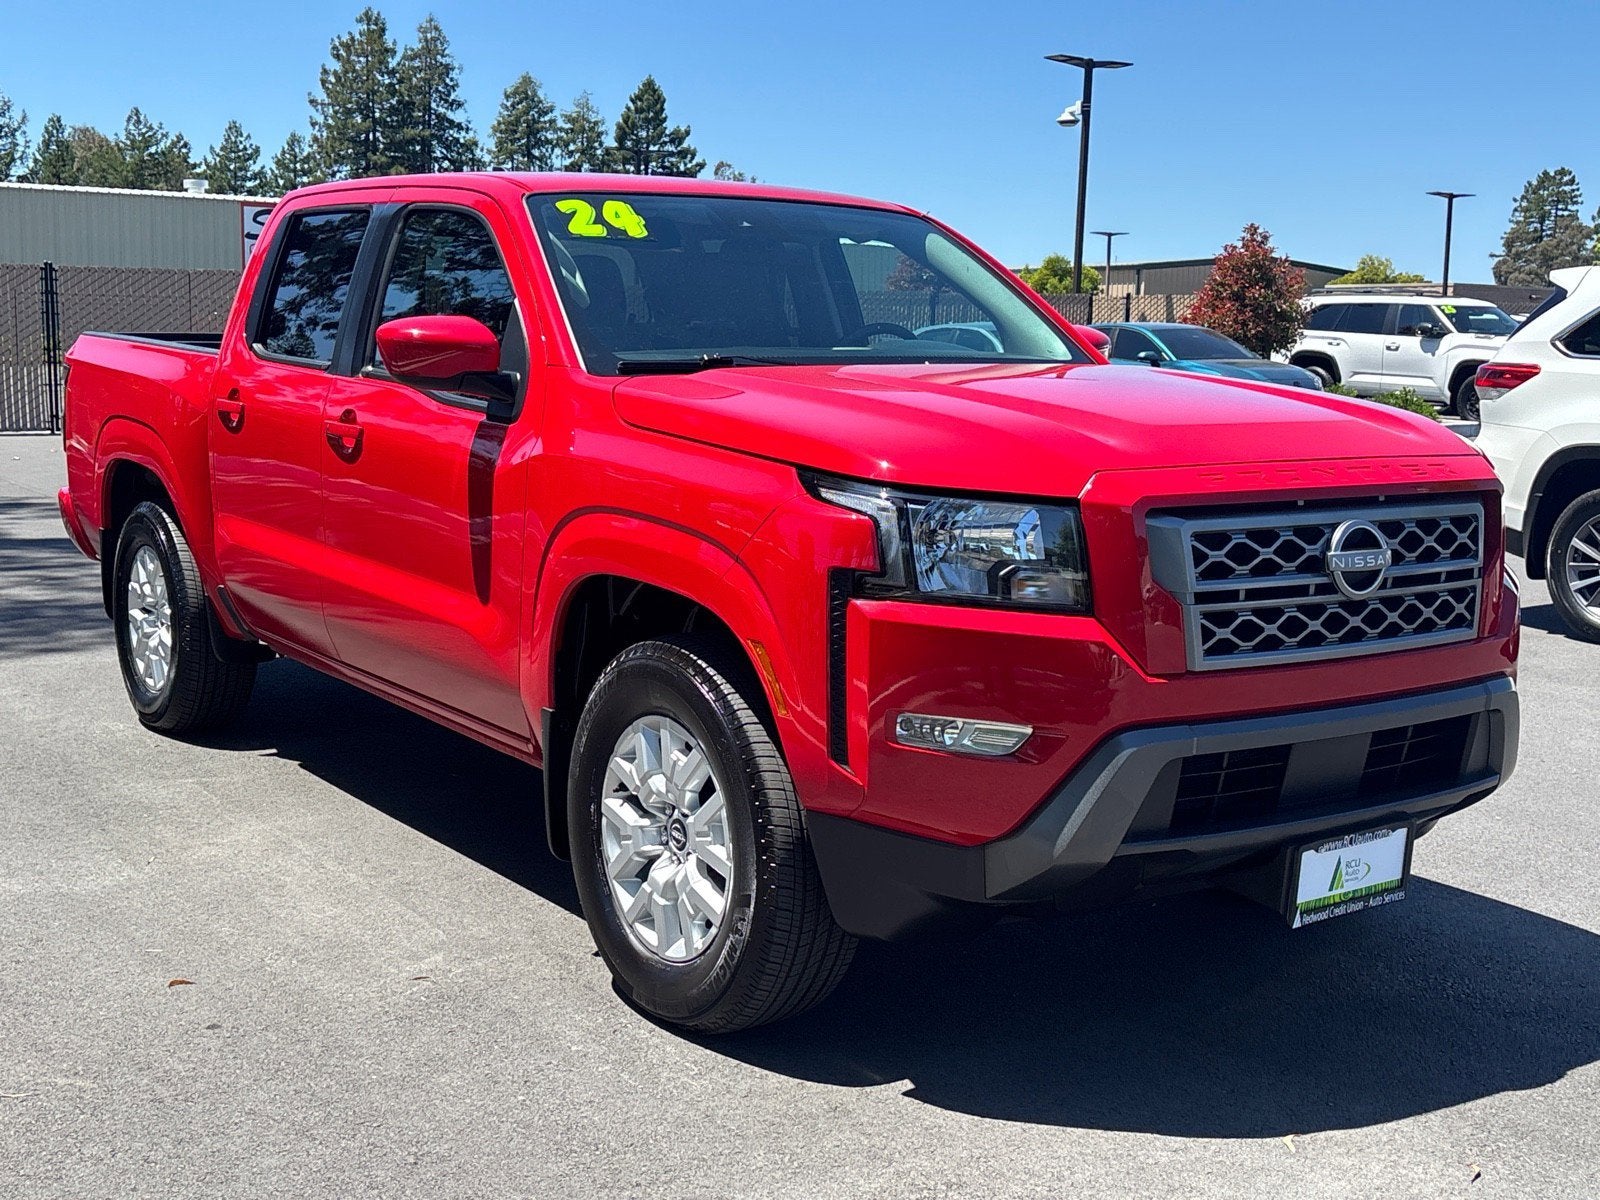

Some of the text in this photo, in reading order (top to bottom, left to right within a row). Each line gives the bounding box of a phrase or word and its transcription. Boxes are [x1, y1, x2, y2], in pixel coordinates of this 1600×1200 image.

[555, 199, 648, 238] 24
[1345, 858, 1361, 869] RCU
[1302, 909, 1329, 925] Redwood
[1329, 904, 1346, 918] Credit
[1346, 901, 1364, 913] Union
[1369, 896, 1383, 908] Auto
[1383, 890, 1406, 904] Services
